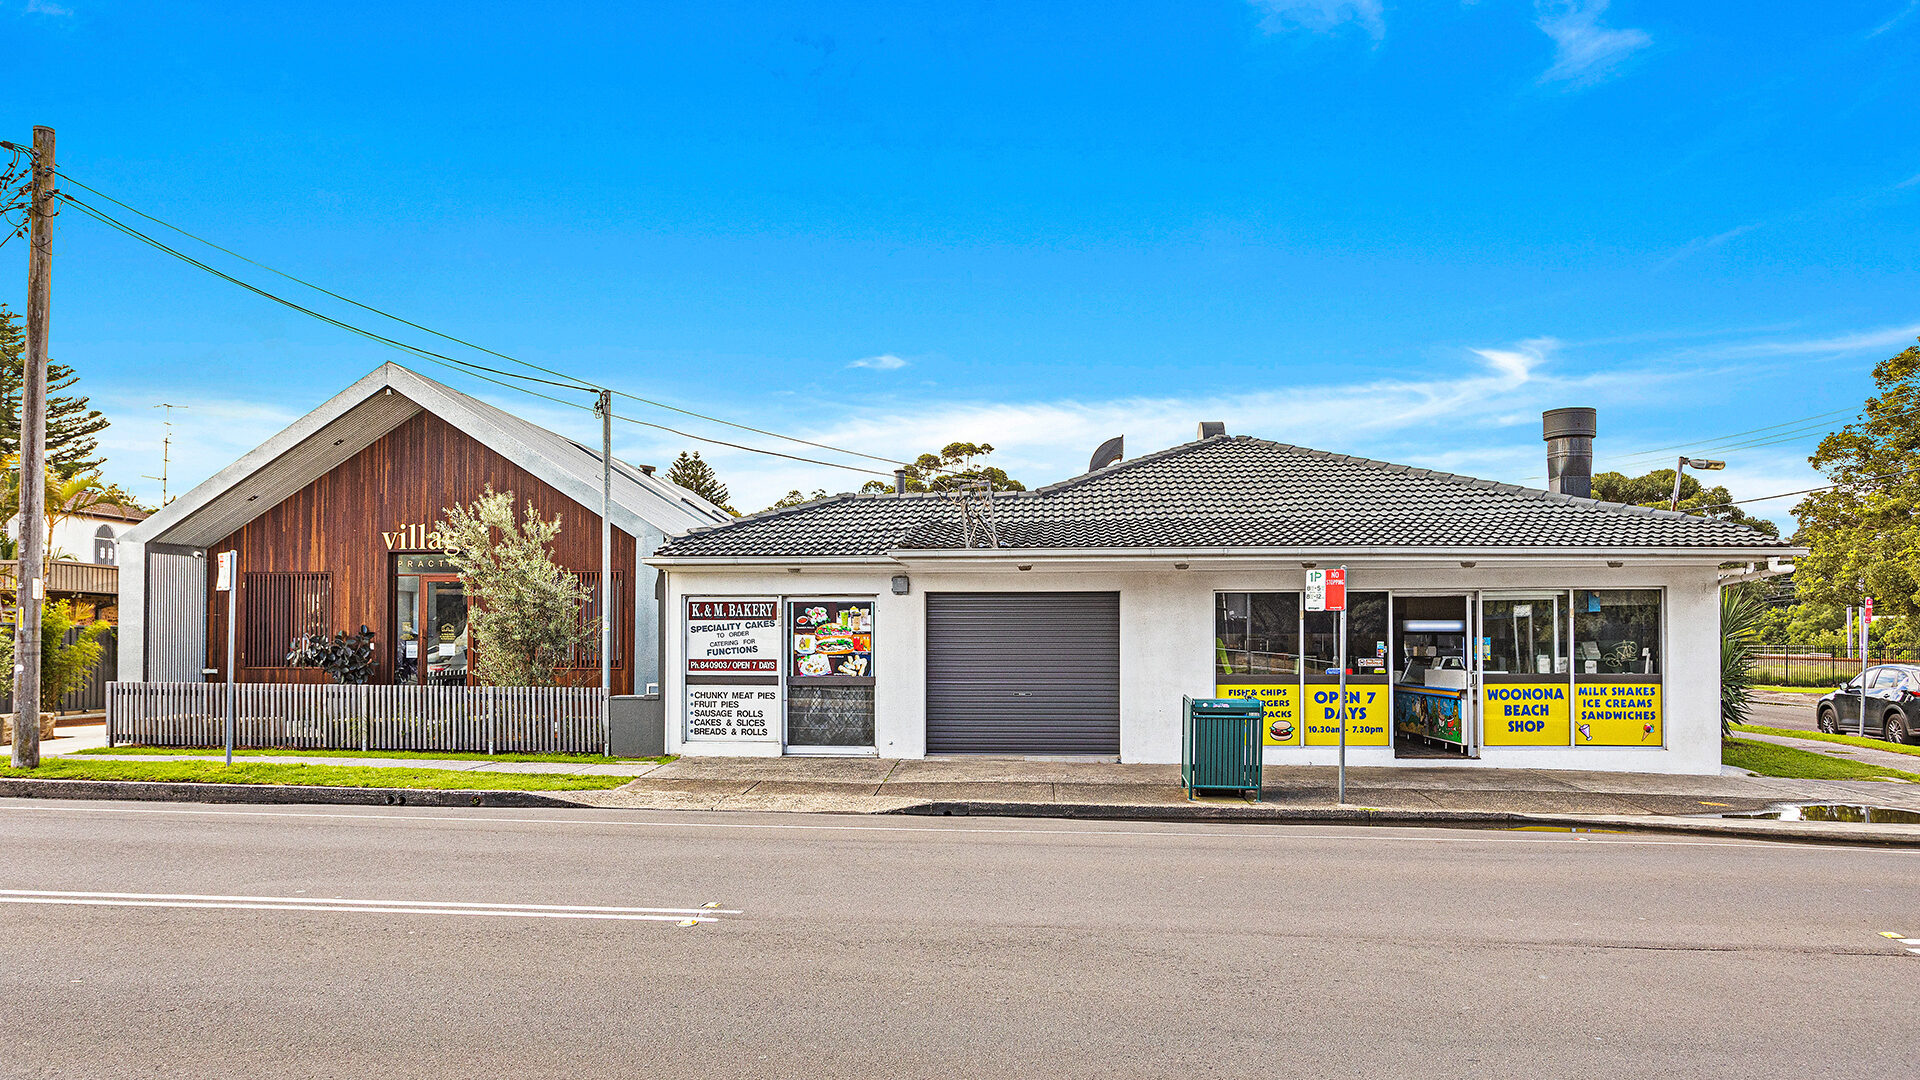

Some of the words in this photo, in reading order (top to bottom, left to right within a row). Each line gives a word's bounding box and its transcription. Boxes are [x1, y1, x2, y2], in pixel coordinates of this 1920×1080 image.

[1310, 571, 1322, 582] 1P
[692, 604, 703, 617] K.
[704, 604, 712, 617] &
[714, 604, 726, 617] M.
[729, 604, 774, 617] BAKERY
[690, 622, 741, 633] SPECIALITY
[745, 620, 775, 629] CAKES
[707, 646, 758, 656] FUNCTIONS
[1487, 688, 1564, 700] WOONONA
[1578, 687, 1607, 696] MILK
[1612, 687, 1655, 696] SHAKES
[1367, 692, 1376, 704] 7
[1583, 699, 1600, 708] ICE
[1605, 699, 1652, 708] CREAMS
[1325, 707, 1367, 719] DAYS
[1504, 704, 1549, 716] BEACH
[1581, 711, 1656, 720] SANDWICHES
[1352, 726, 1383, 734] 7.30pm
[1508, 720, 1545, 732] SHOP
